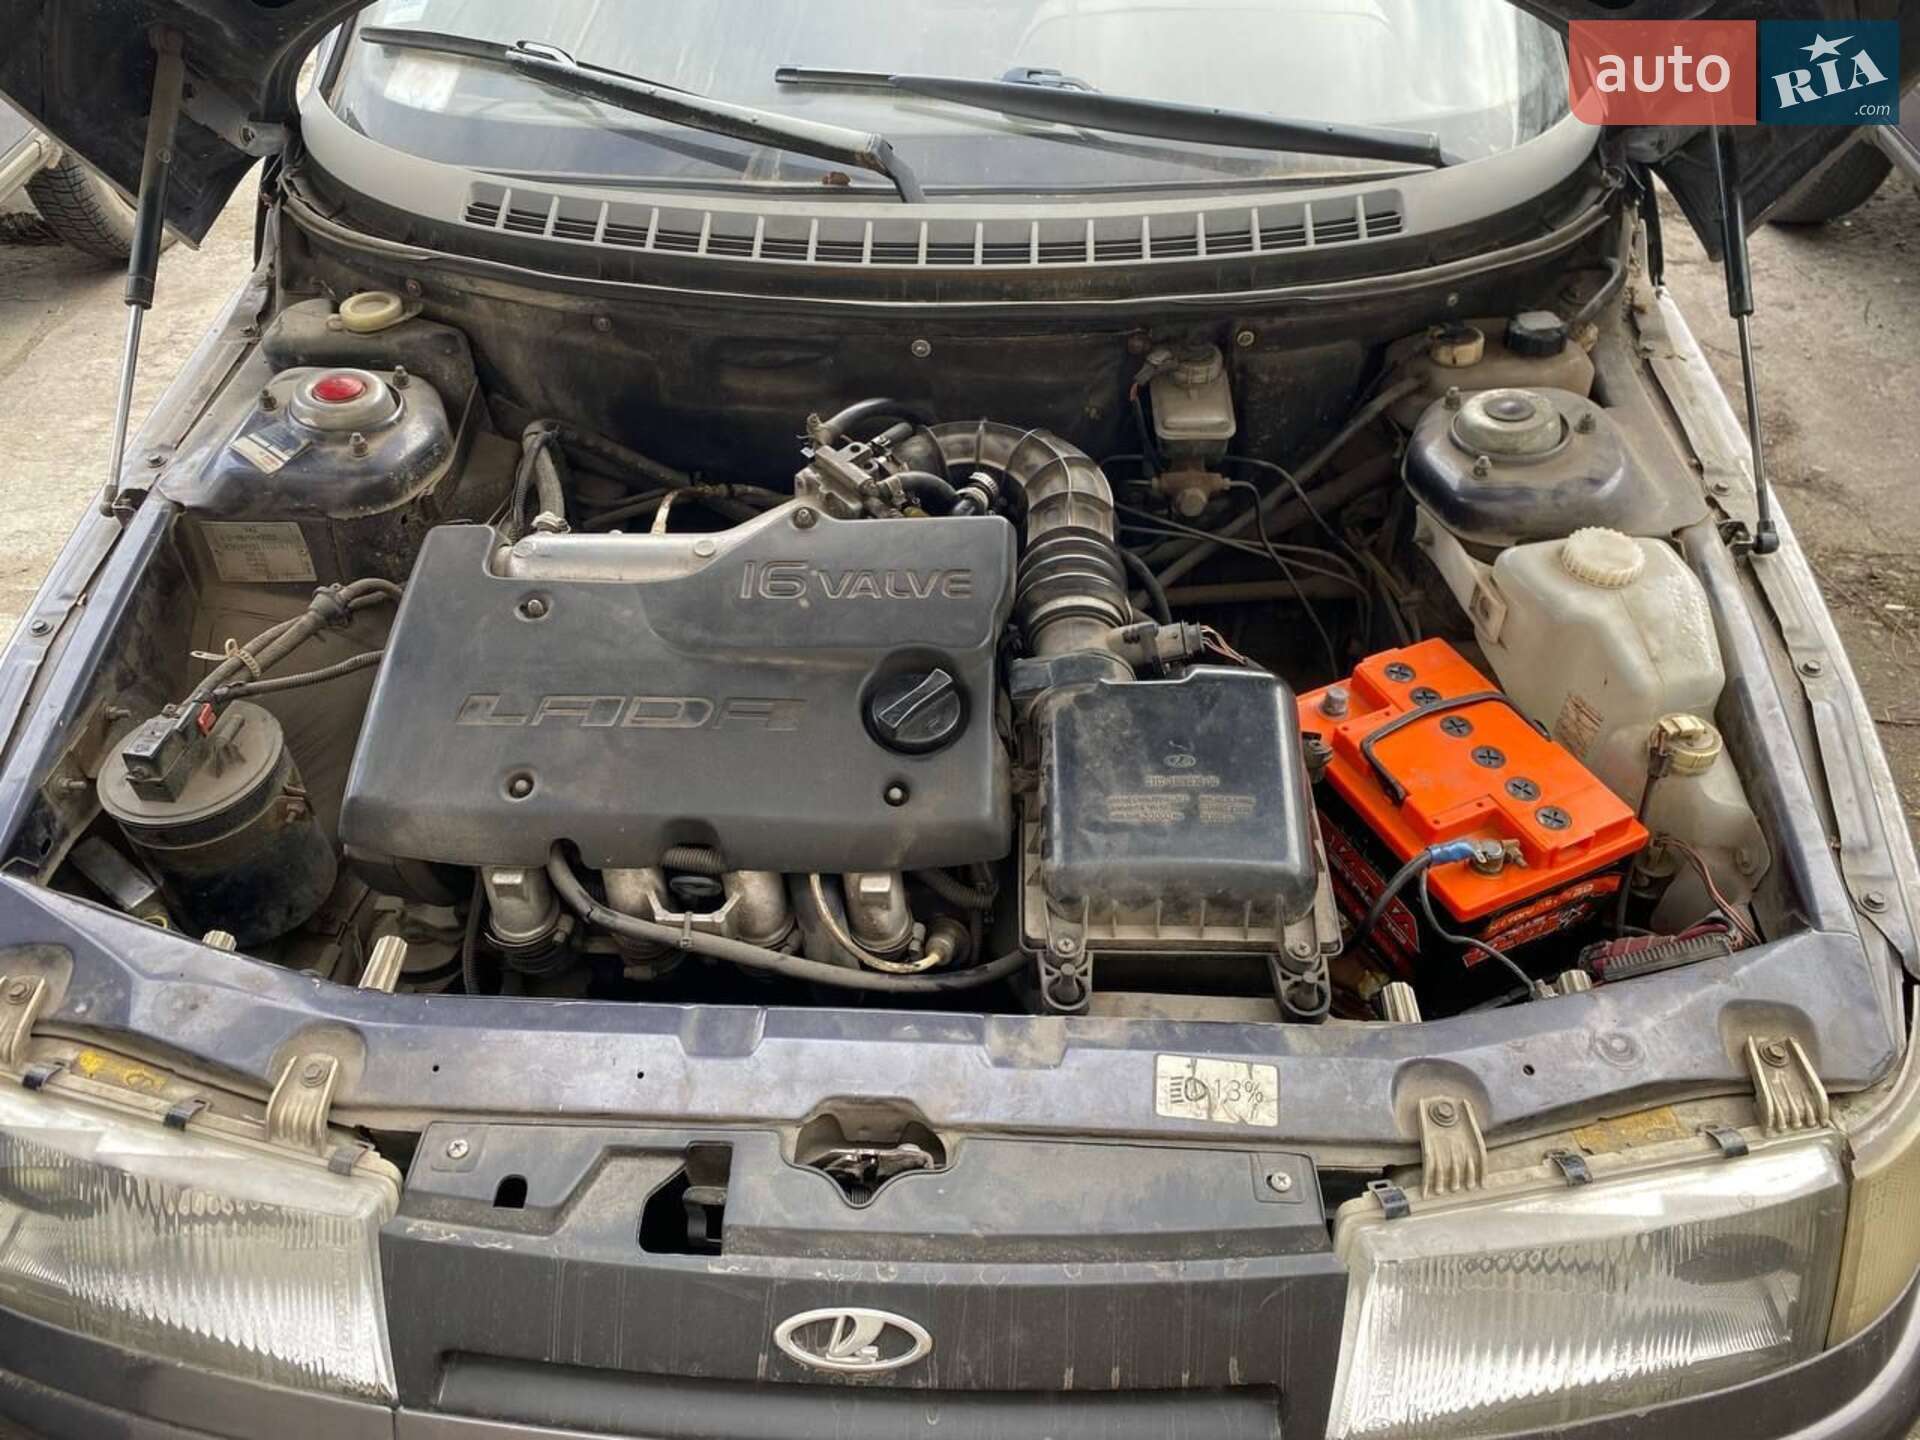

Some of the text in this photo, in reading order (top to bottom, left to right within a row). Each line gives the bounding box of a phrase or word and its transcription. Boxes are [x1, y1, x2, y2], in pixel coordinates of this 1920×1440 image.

[740, 560, 974, 600] 16 VALVE
[456, 693, 806, 731] LADA
